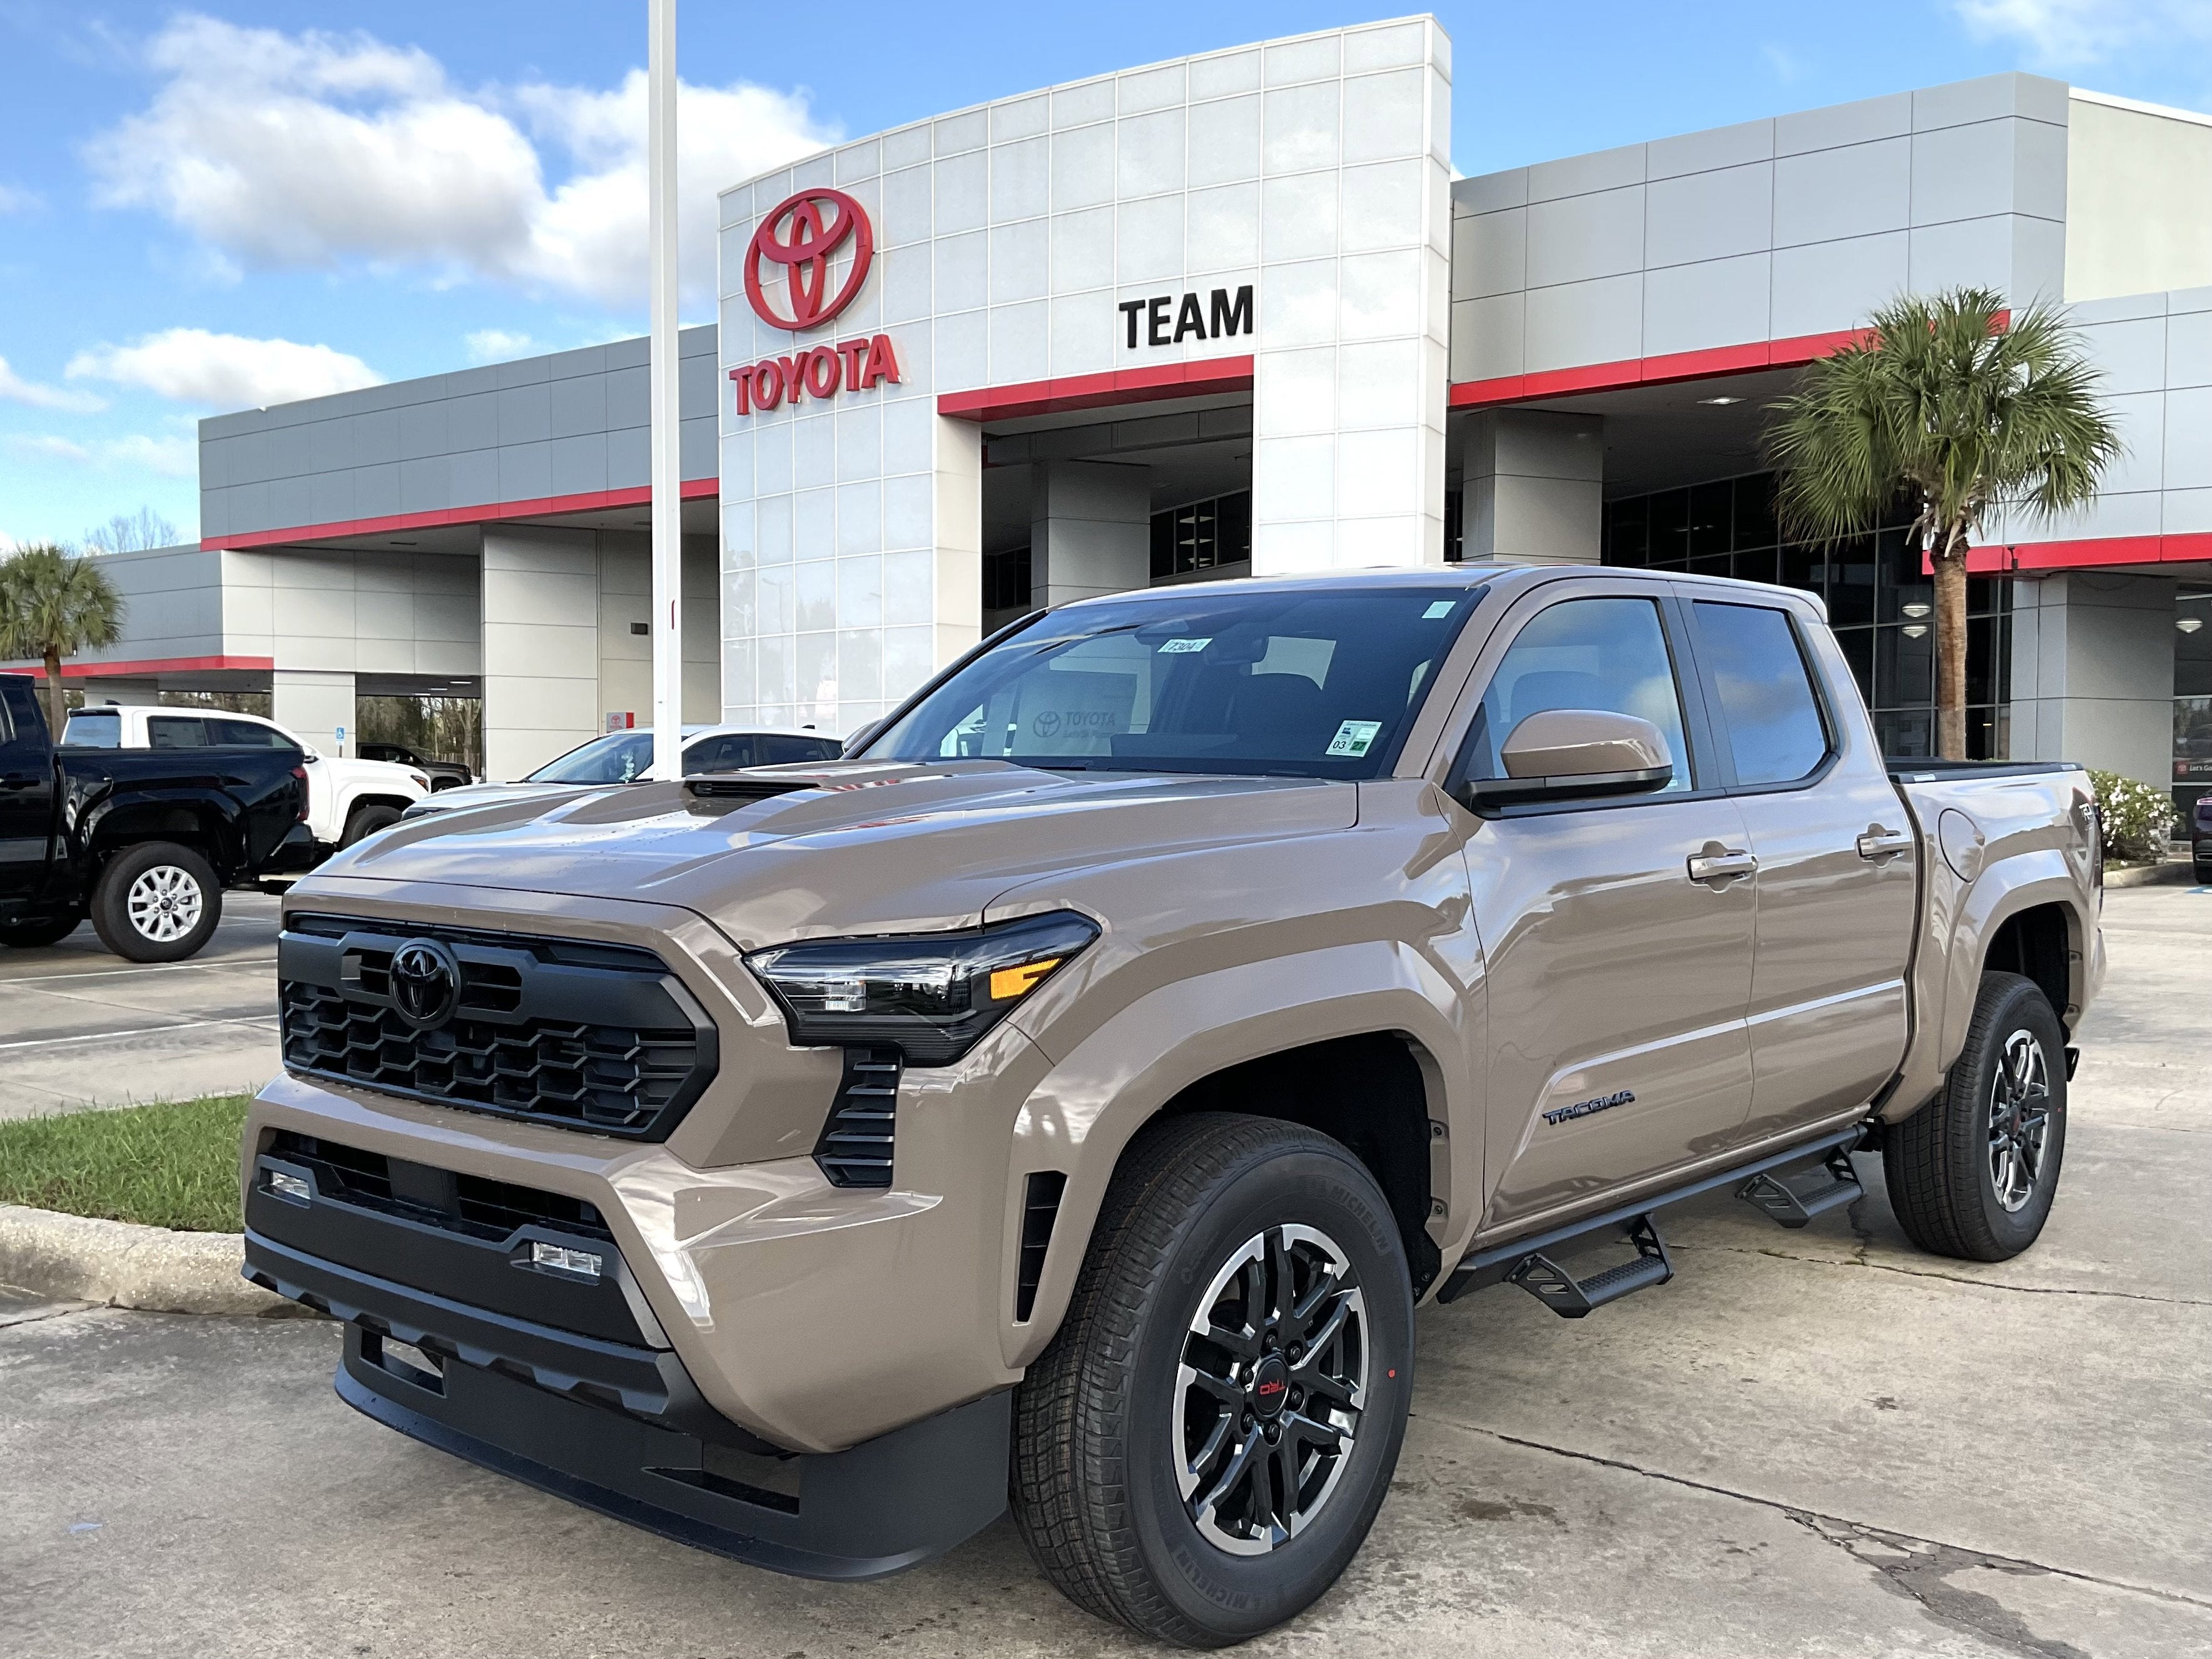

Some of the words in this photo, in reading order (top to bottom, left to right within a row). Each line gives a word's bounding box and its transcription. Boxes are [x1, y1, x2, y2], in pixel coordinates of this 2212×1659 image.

[1119, 285, 1253, 348] TEAM
[729, 333, 902, 415] TOYOTA
[1065, 711, 1115, 726] TOYOTA
[1333, 741, 1346, 749] 03
[1351, 741, 1367, 750] 27
[1542, 1090, 1635, 1125] TACOMA
[1330, 1185, 1389, 1251] MICHELIN
[1260, 1379, 1286, 1395] TRD
[1176, 1550, 1249, 1609] MICHELIN
